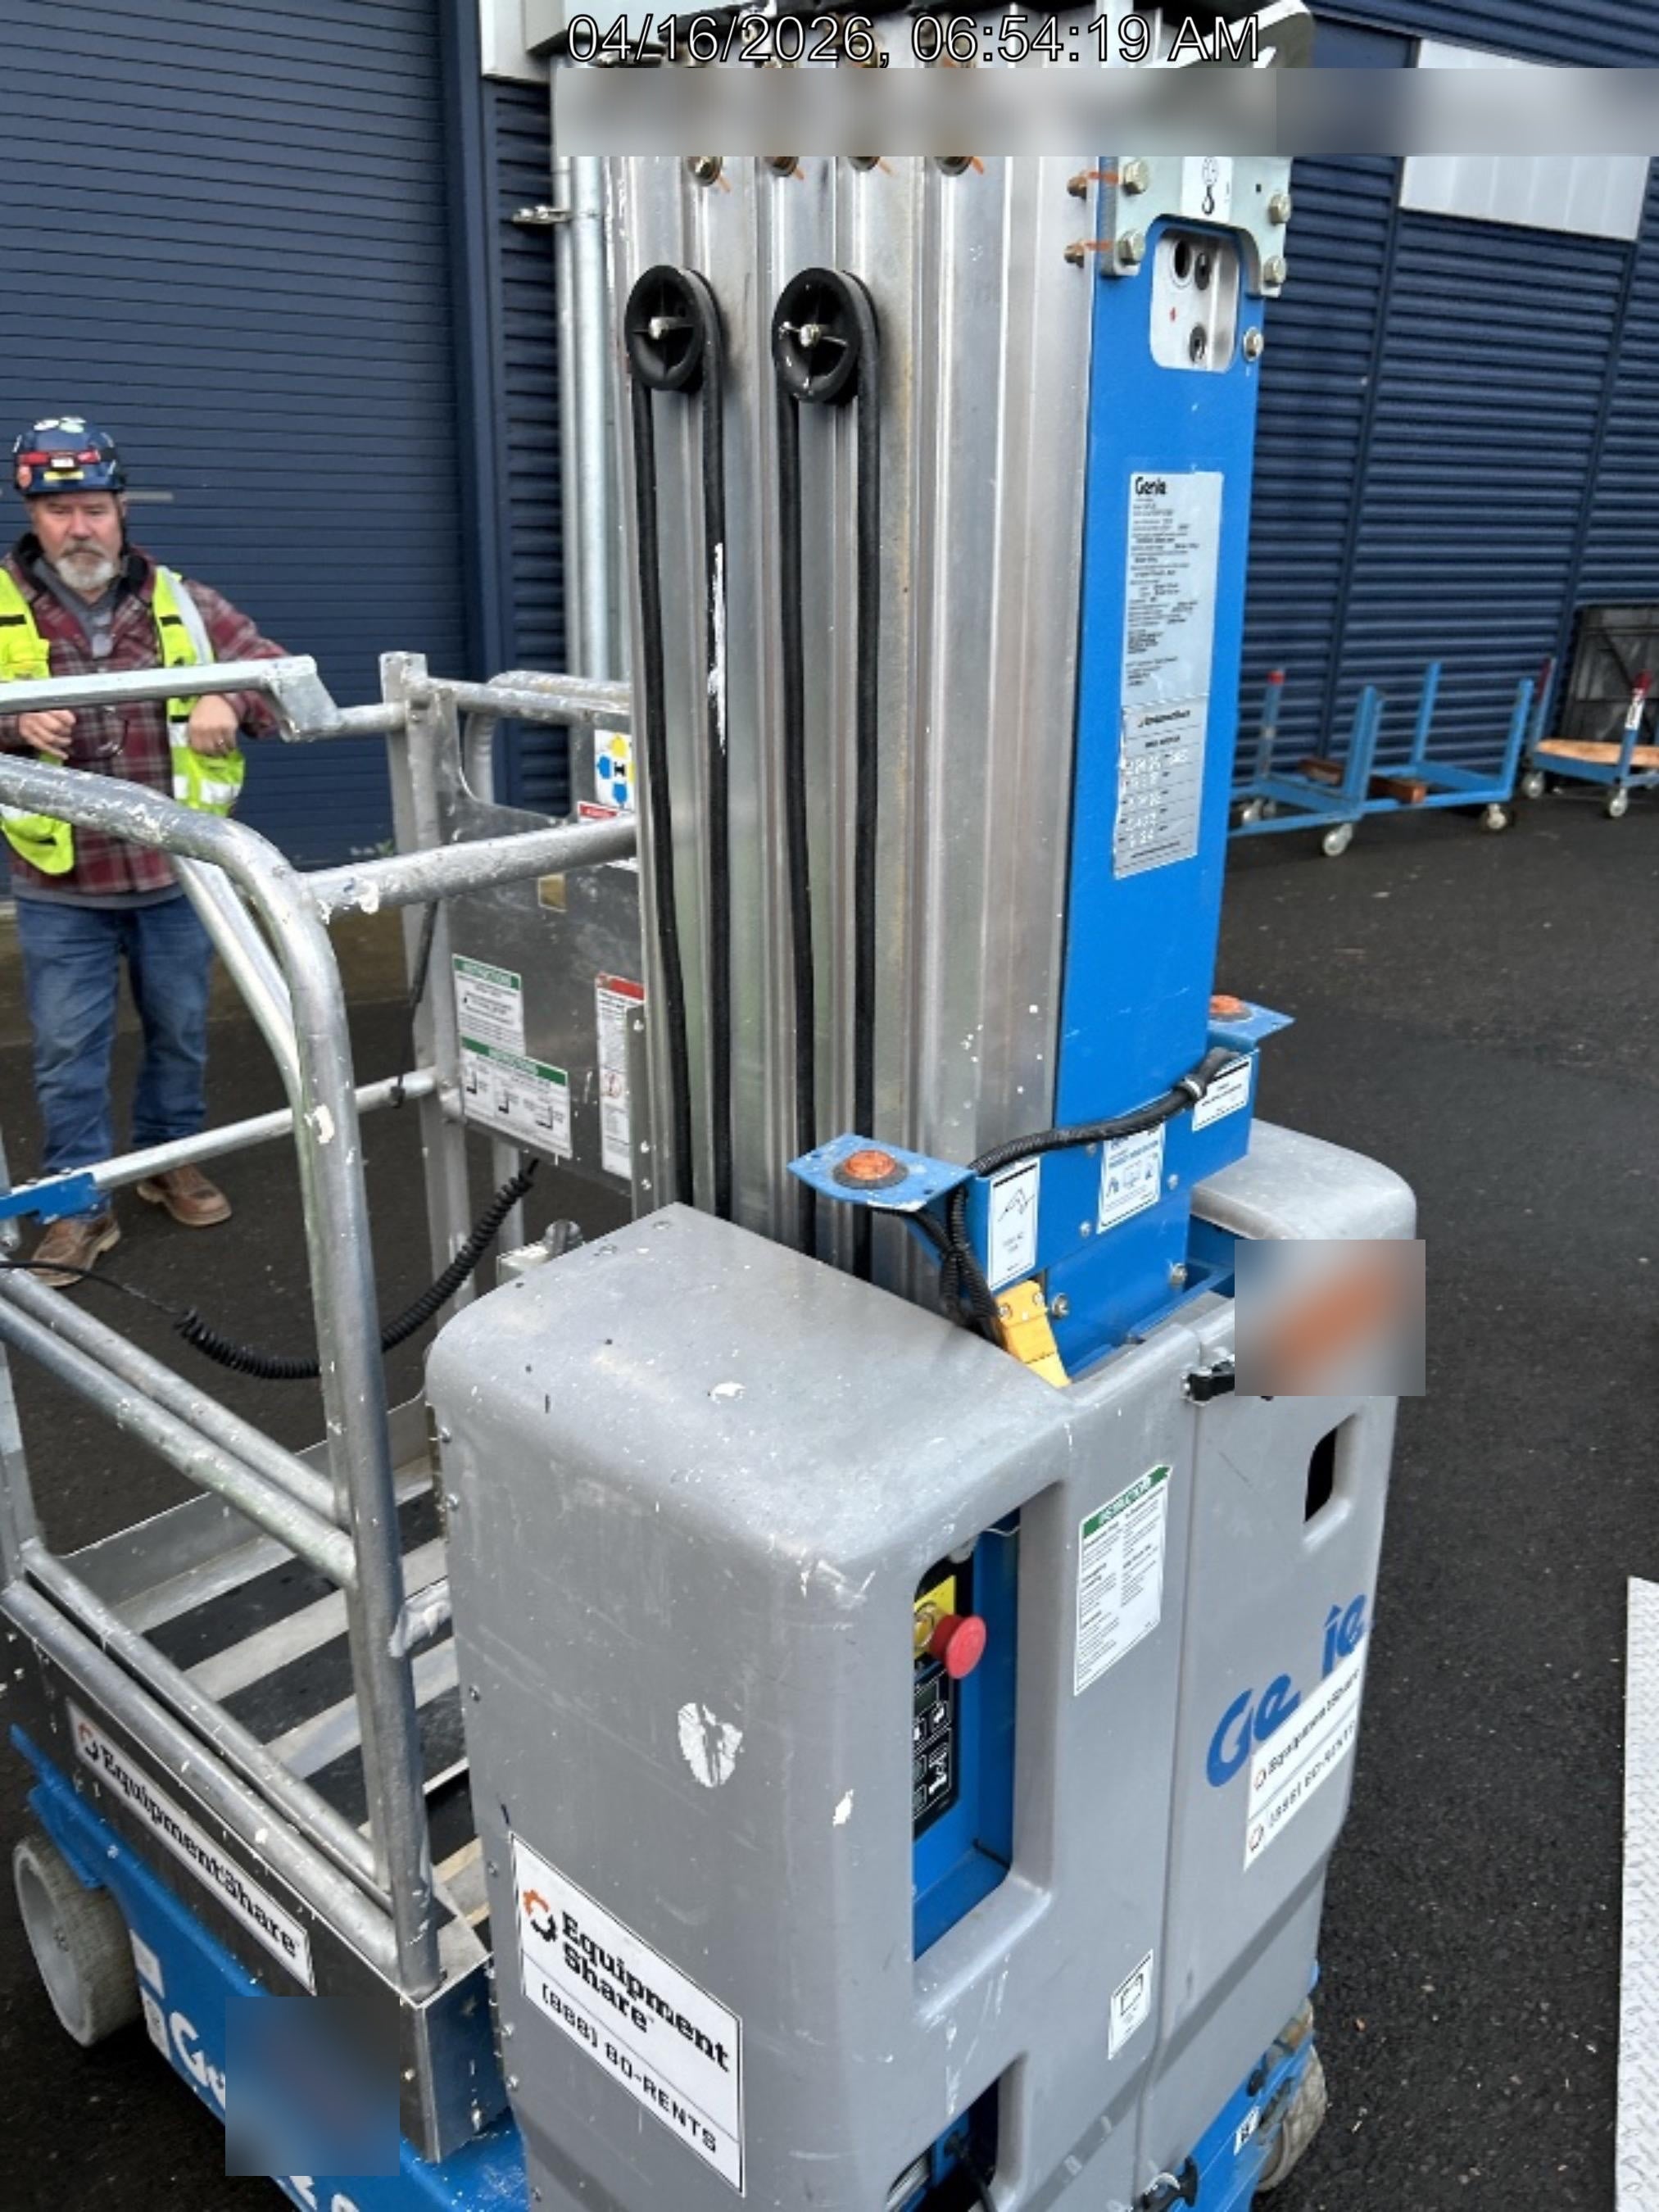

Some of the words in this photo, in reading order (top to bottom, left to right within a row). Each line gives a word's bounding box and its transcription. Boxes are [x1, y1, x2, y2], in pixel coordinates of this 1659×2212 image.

[1135, 476, 1167, 496] Genie
[562, 1911, 730, 2073] Equipment
[564, 1942, 648, 2033] Share
[542, 1982, 598, 2048] (888)
[605, 2042, 717, 2154] 80-RENTS
